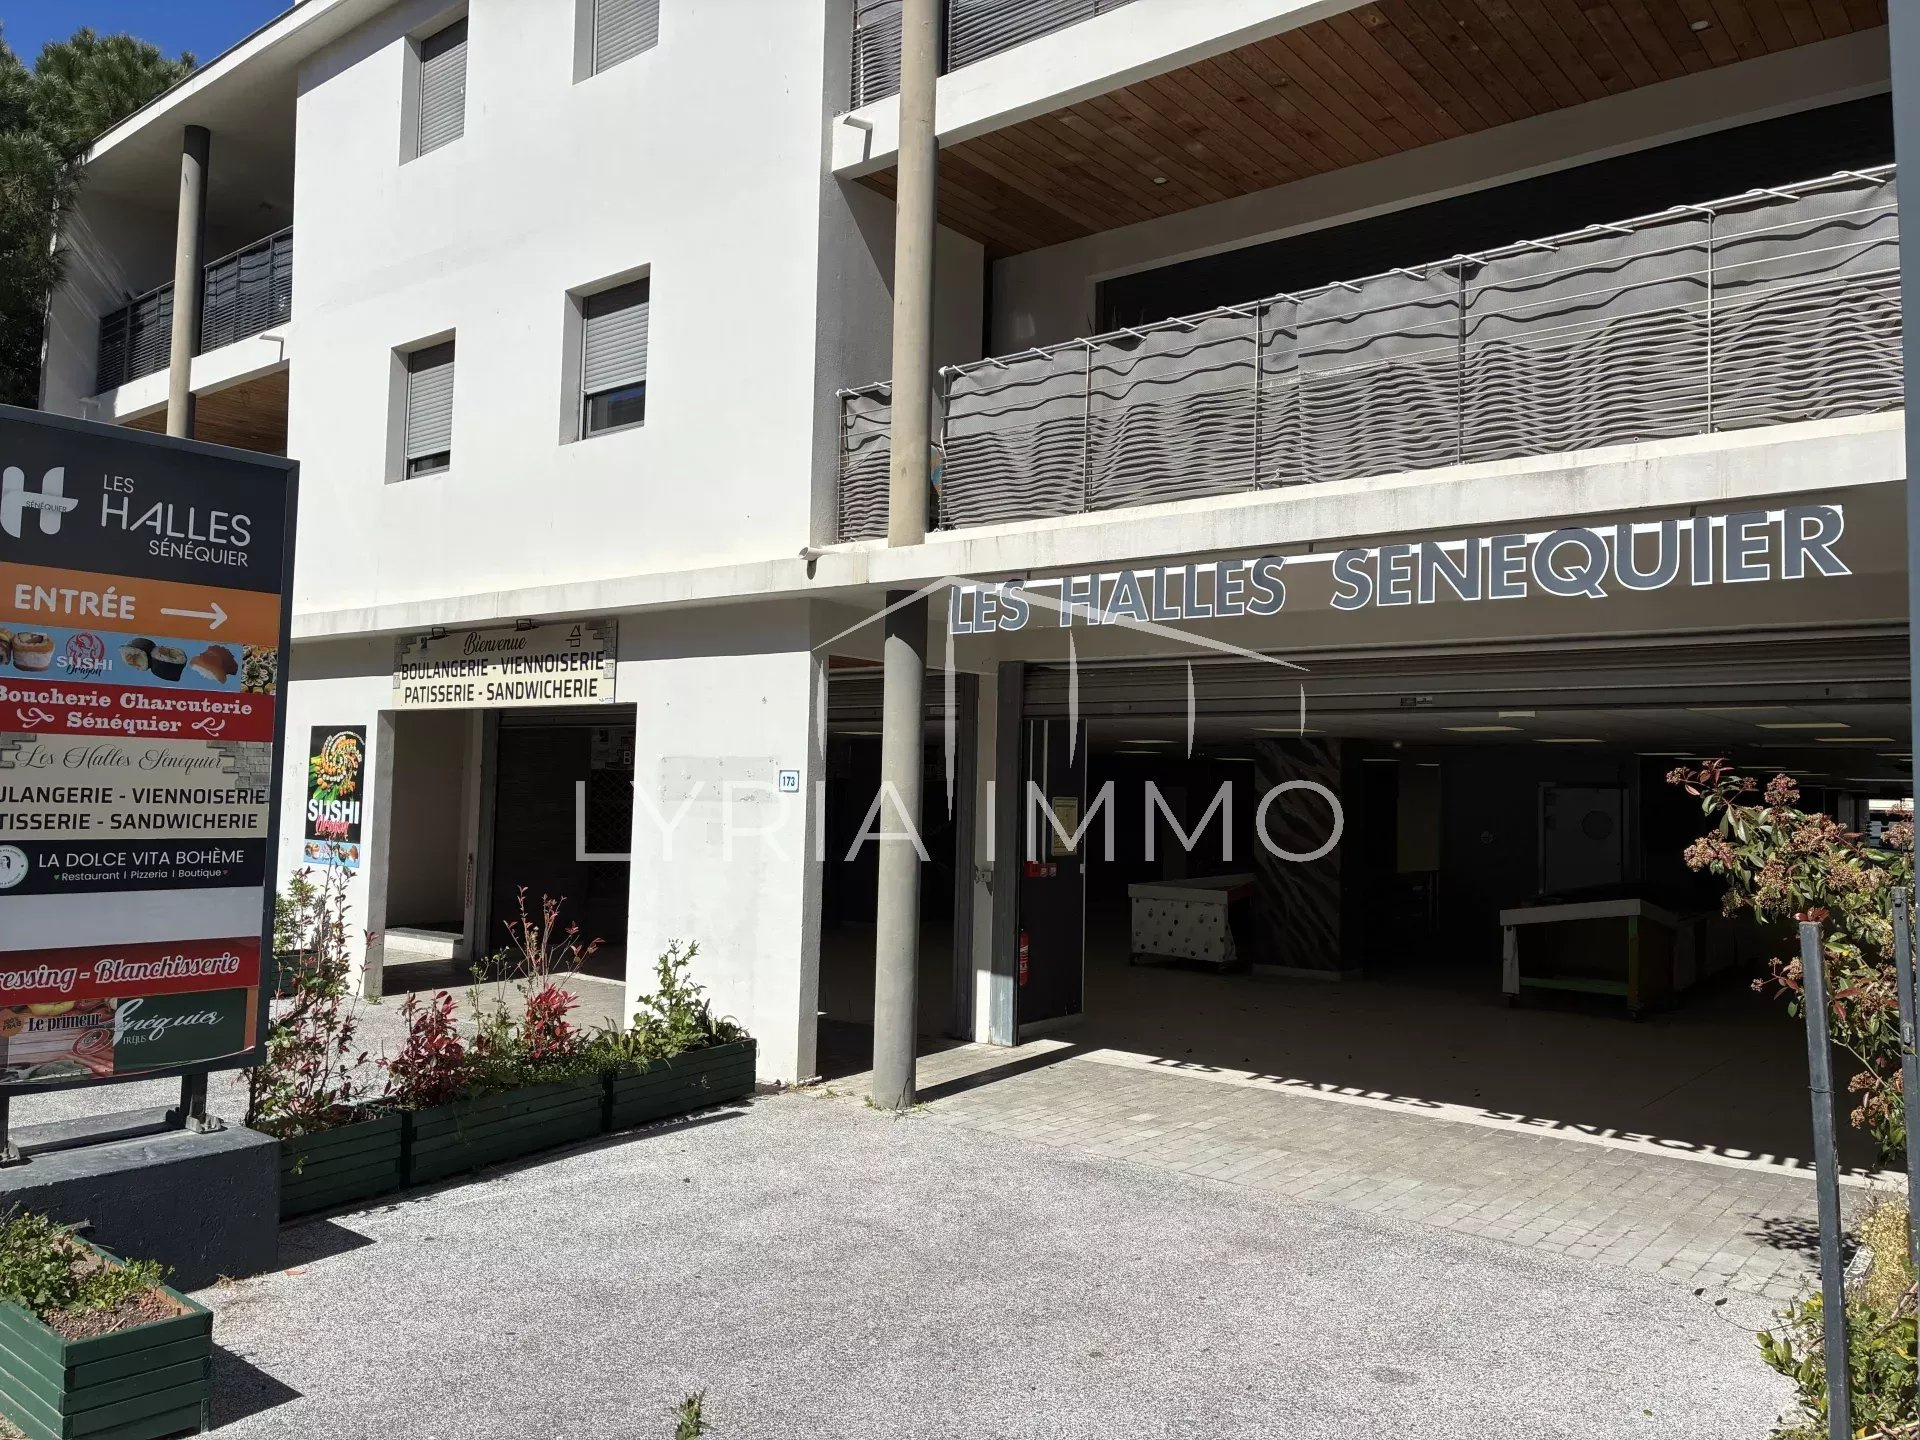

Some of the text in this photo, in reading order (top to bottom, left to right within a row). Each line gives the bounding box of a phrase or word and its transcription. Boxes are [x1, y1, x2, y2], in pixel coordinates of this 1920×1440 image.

[103, 474, 135, 494] LES
[101, 493, 251, 547] HALLES
[148, 538, 249, 567] SÉNÉQUIER
[949, 503, 1853, 635] LES HALLES SENEQUIER
[14, 583, 136, 620] ENTRÉE
[463, 632, 527, 655] Bienvenue
[56, 655, 113, 671] SUSHI
[66, 664, 102, 680] Dragon
[401, 658, 489, 681] BOULANGERIE
[500, 651, 605, 675] VIENNOISERIE
[404, 683, 475, 703] PATISSERIE
[486, 678, 598, 700] SANDWICHERIE
[119, 692, 252, 715] Charcuterie
[67, 711, 182, 735] Sénéquier
[15, 744, 54, 769] Les
[63, 744, 131, 769] Halles
[782, 776, 795, 787] 173
[132, 787, 266, 805] VIENNOISERIE
[110, 812, 258, 830] SANDWICHERIE
[307, 799, 361, 824] SUSHI
[39, 847, 245, 868] LA DOLCE VITA BOHÈME
[61, 870, 120, 882] Restaurant
[131, 869, 168, 879] Pizzeria
[178, 867, 222, 879] Boutique
[0, 964, 77, 993] essing
[94, 952, 240, 984] Blanchisserie
[28, 1013, 102, 1032] Le primeur
